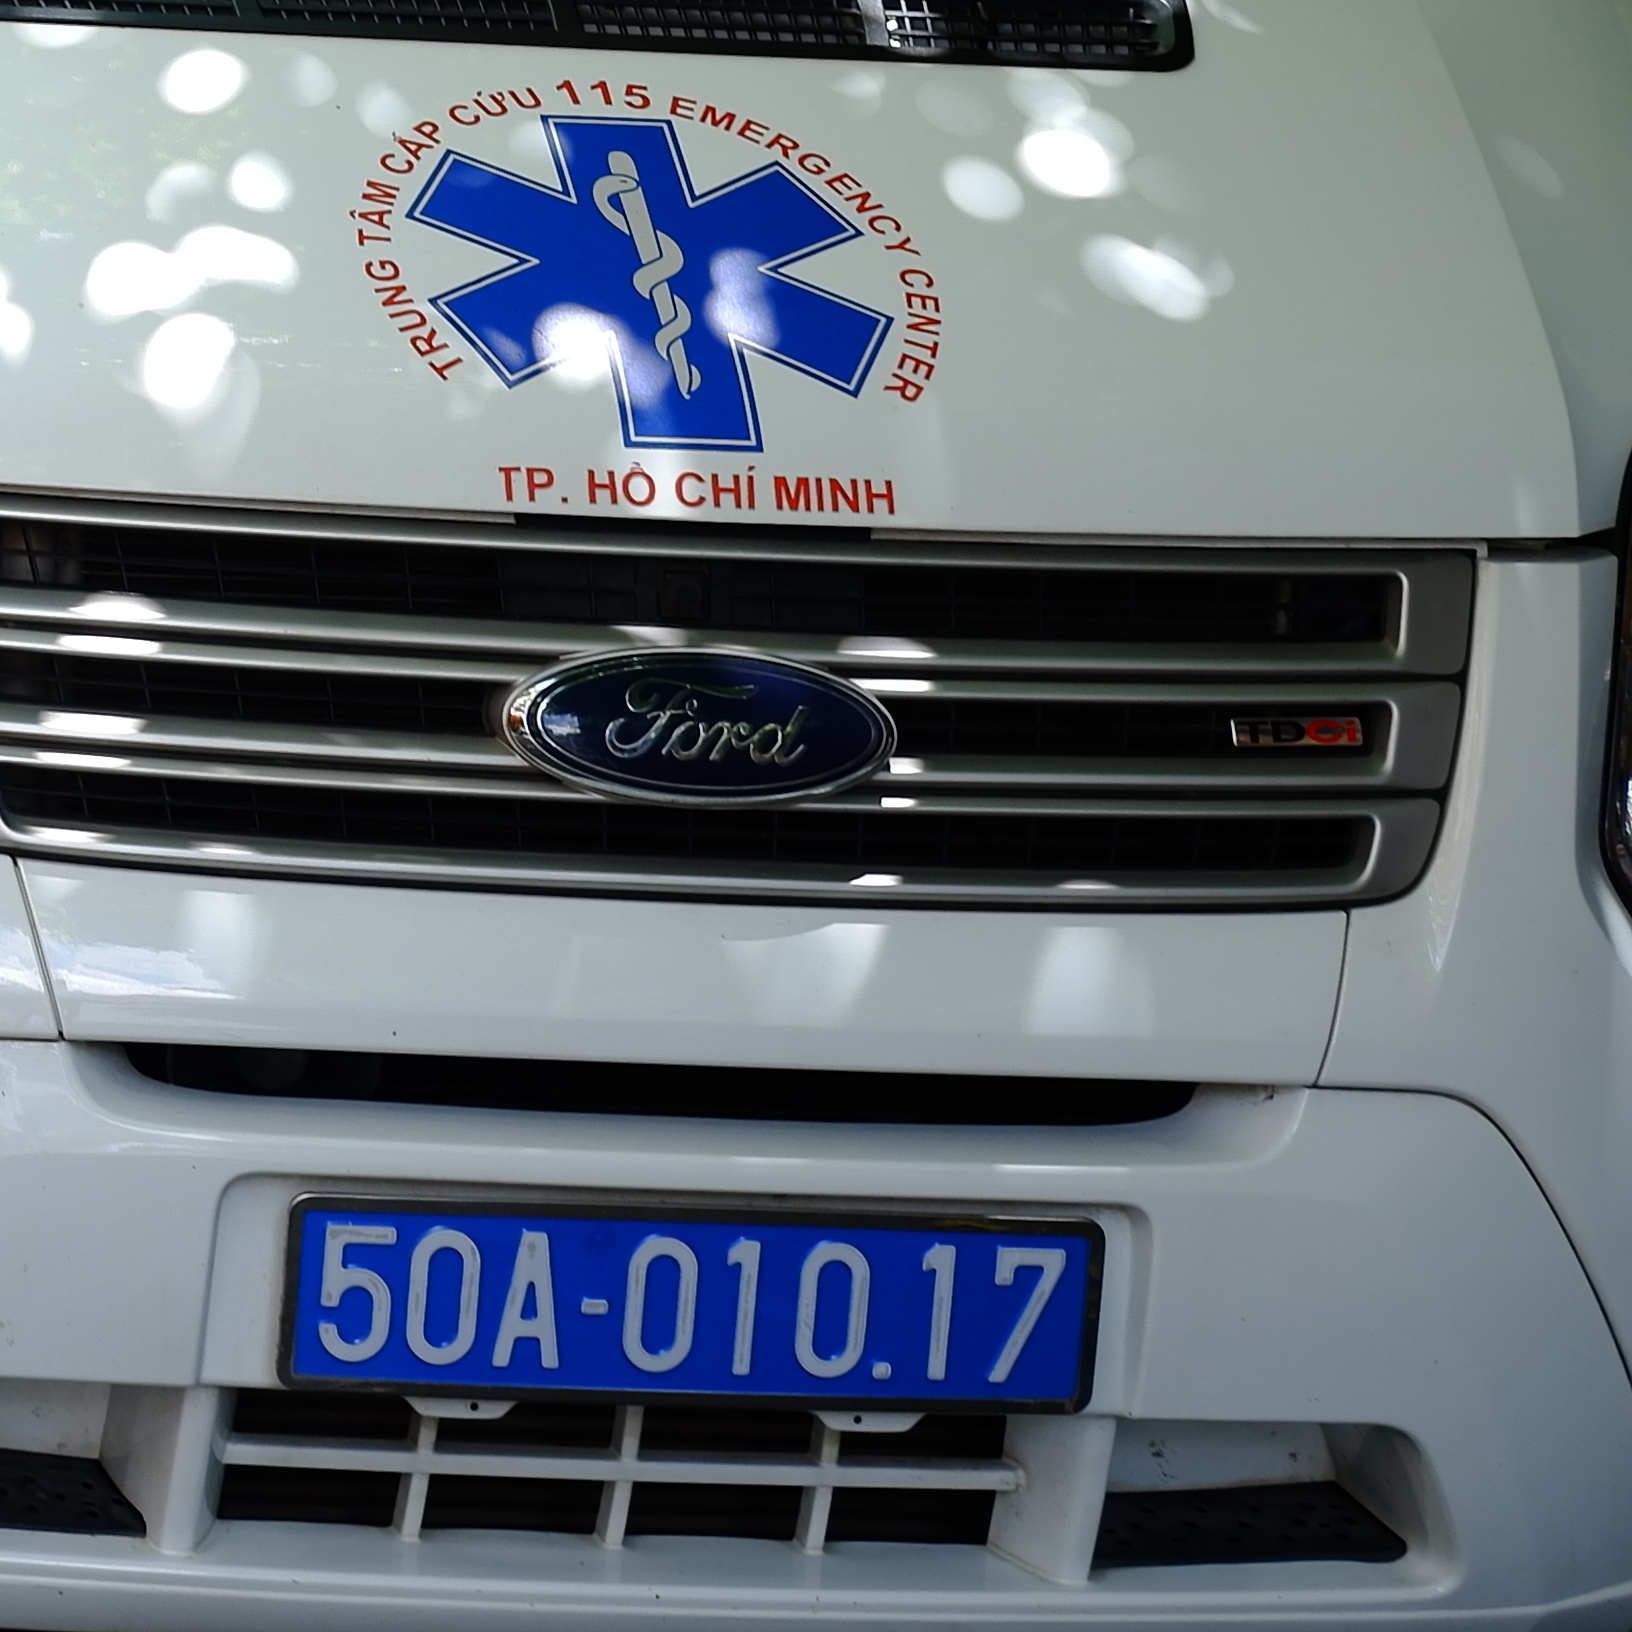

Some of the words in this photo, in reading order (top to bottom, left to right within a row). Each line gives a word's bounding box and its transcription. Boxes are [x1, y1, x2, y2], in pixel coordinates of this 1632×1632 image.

[448, 86, 542, 126] CỨU
[555, 79, 651, 110] 115
[379, 120, 442, 175] CẤP
[669, 95, 922, 257] EMERGENCY
[349, 179, 400, 247] TÂM
[364, 259, 463, 382] TRUNG
[883, 268, 942, 403] CENTER
[498, 466, 569, 504] TP.
[587, 461, 657, 507] HỒ
[674, 465, 756, 510] CHÍ
[773, 475, 896, 515] MINH
[604, 676, 809, 766] Ford
[1236, 718, 1361, 745] TDCi
[316, 1221, 1067, 1384] 50A-010.17
